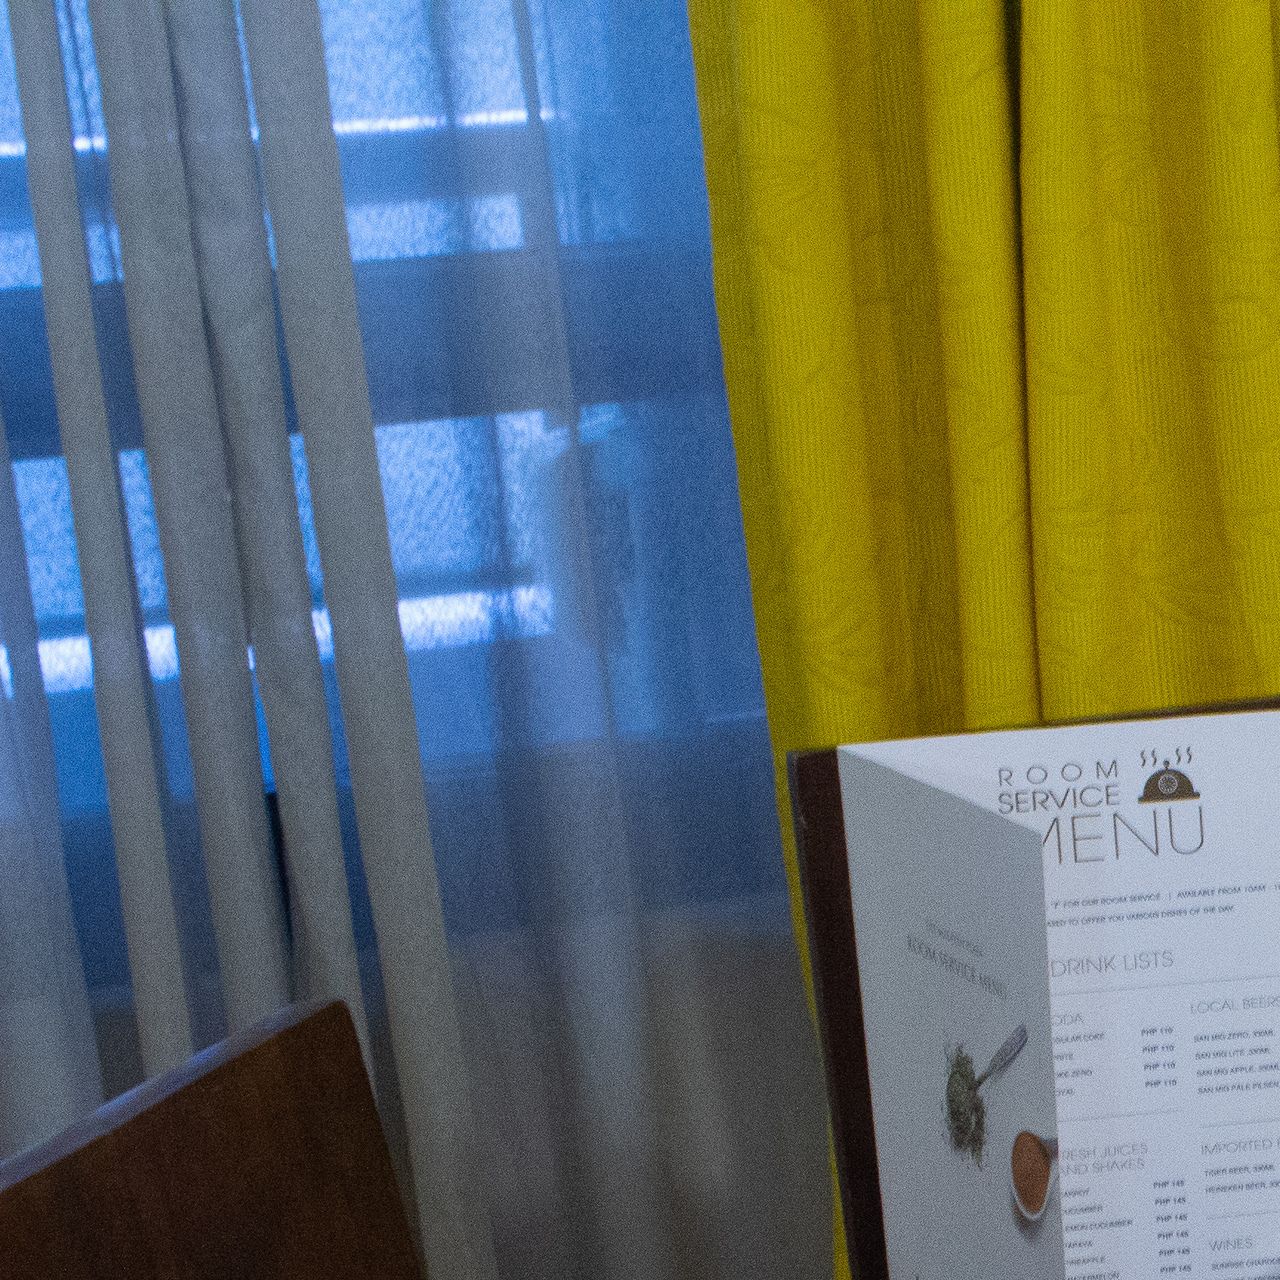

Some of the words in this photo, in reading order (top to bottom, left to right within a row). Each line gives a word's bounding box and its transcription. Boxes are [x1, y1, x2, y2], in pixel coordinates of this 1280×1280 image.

[998, 759, 1119, 787] ROOM
[998, 784, 1121, 814] SERVICE
[1100, 896, 1127, 905] ROOM
[1129, 892, 1161, 902] SERVICE
[1177, 889, 1215, 899] AVAILABLE
[1218, 886, 1241, 895] FROM
[1108, 913, 1125, 922] YOU
[1050, 953, 1116, 978] DRINK
[1123, 950, 1175, 972] LISTS
[1190, 999, 1238, 1015] LOCAL
[1051, 1013, 1085, 1026] ODA
[1141, 1028, 1157, 1037] PHP
[1193, 1034, 1209, 1043] SAN
[1142, 1045, 1159, 1054] PHP
[1144, 1062, 1160, 1071] PHP
[1145, 1079, 1162, 1088] PHP
[1061, 1146, 1096, 1161] RESH
[1100, 1142, 1148, 1158] JUICES
[1201, 1138, 1273, 1155] IMPORTED
[1092, 1157, 1145, 1173] SHAKES
[1153, 1180, 1169, 1189] PHP
[1172, 1179, 1186, 1188] 145
[1154, 1197, 1170, 1206] PHP
[1172, 1196, 1186, 1204] 145
[1065, 1224, 1088, 1232] EMON
[1156, 1214, 1172, 1223] PHP
[1174, 1213, 1188, 1222] 145
[1157, 1231, 1173, 1240] PHP
[1176, 1230, 1190, 1238] 145
[1208, 1238, 1253, 1251] WINES
[1159, 1248, 1175, 1257] PHP
[1178, 1247, 1192, 1256] 145
[1160, 1265, 1176, 1274] PHP
[1178, 1264, 1192, 1272] 145
